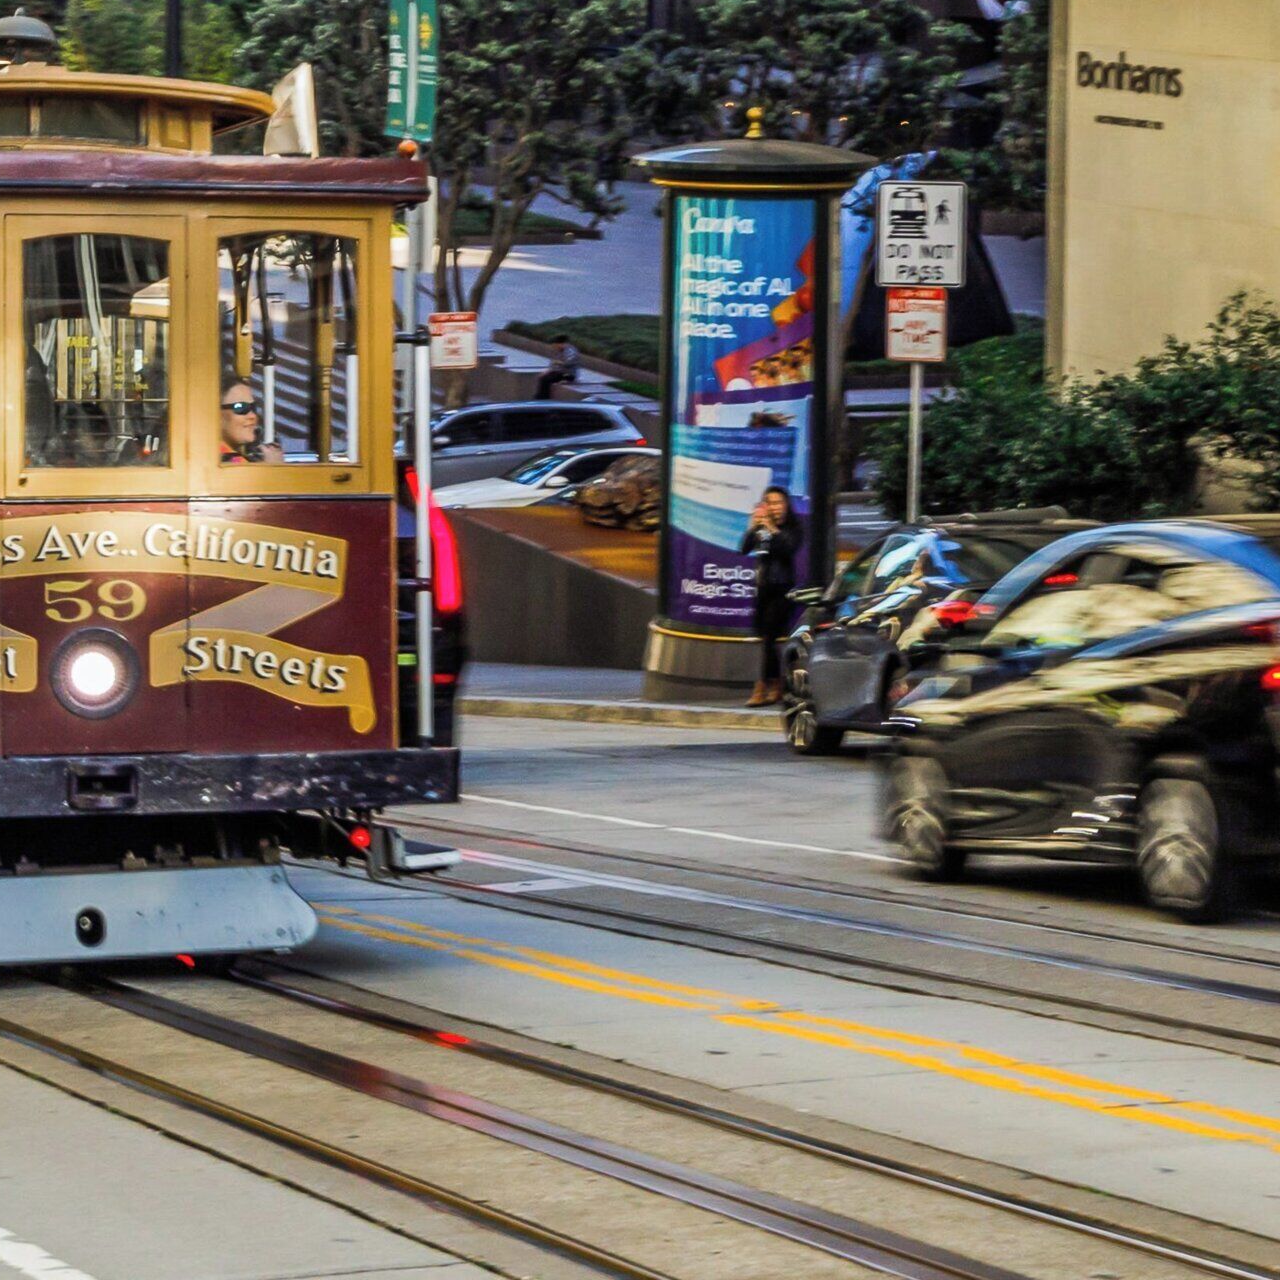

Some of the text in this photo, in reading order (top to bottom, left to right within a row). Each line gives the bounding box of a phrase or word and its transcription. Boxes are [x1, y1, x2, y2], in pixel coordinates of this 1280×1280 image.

[1077, 51, 1183, 97] Bonhams
[683, 207, 755, 234] Canva
[886, 244, 955, 259] DO NOT
[705, 255, 743, 274] the
[897, 265, 944, 280] PASS
[681, 277, 738, 298] magic
[738, 277, 767, 295] of
[724, 302, 769, 317] one
[144, 523, 339, 579] California
[703, 563, 757, 582] Explo
[681, 579, 729, 599] Magic
[45, 578, 148, 623] 59
[183, 636, 349, 693] Streets
